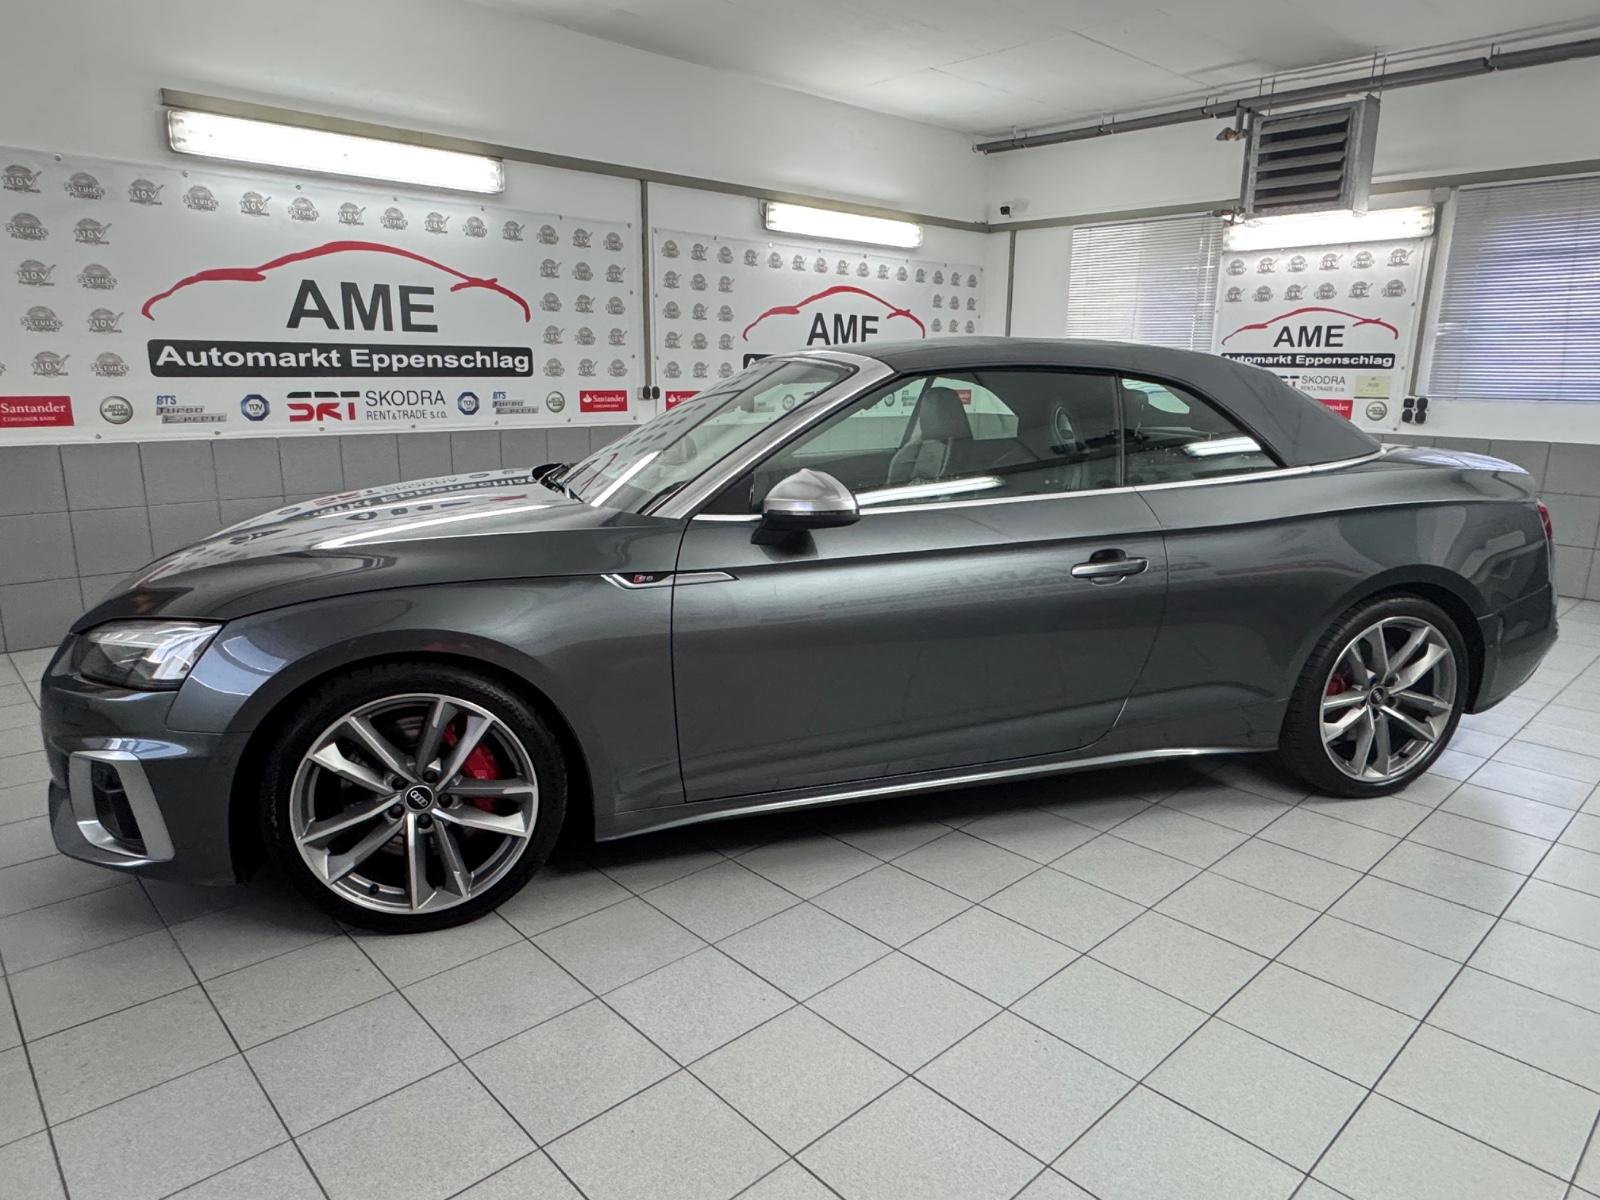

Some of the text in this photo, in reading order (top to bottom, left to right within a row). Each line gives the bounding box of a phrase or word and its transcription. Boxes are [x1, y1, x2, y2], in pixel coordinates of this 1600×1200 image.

[287, 279, 438, 332] AME
[1273, 325, 1345, 347] AME
[156, 345, 341, 367] Automarkt
[351, 348, 529, 372] Eppenschlag
[1296, 355, 1393, 367] Eppenschlag
[1301, 376, 1345, 385] SKODRA
[156, 395, 177, 405] BTS
[366, 390, 446, 407] SKODRA
[592, 394, 625, 403] Santander
[0, 402, 66, 414] Santander
